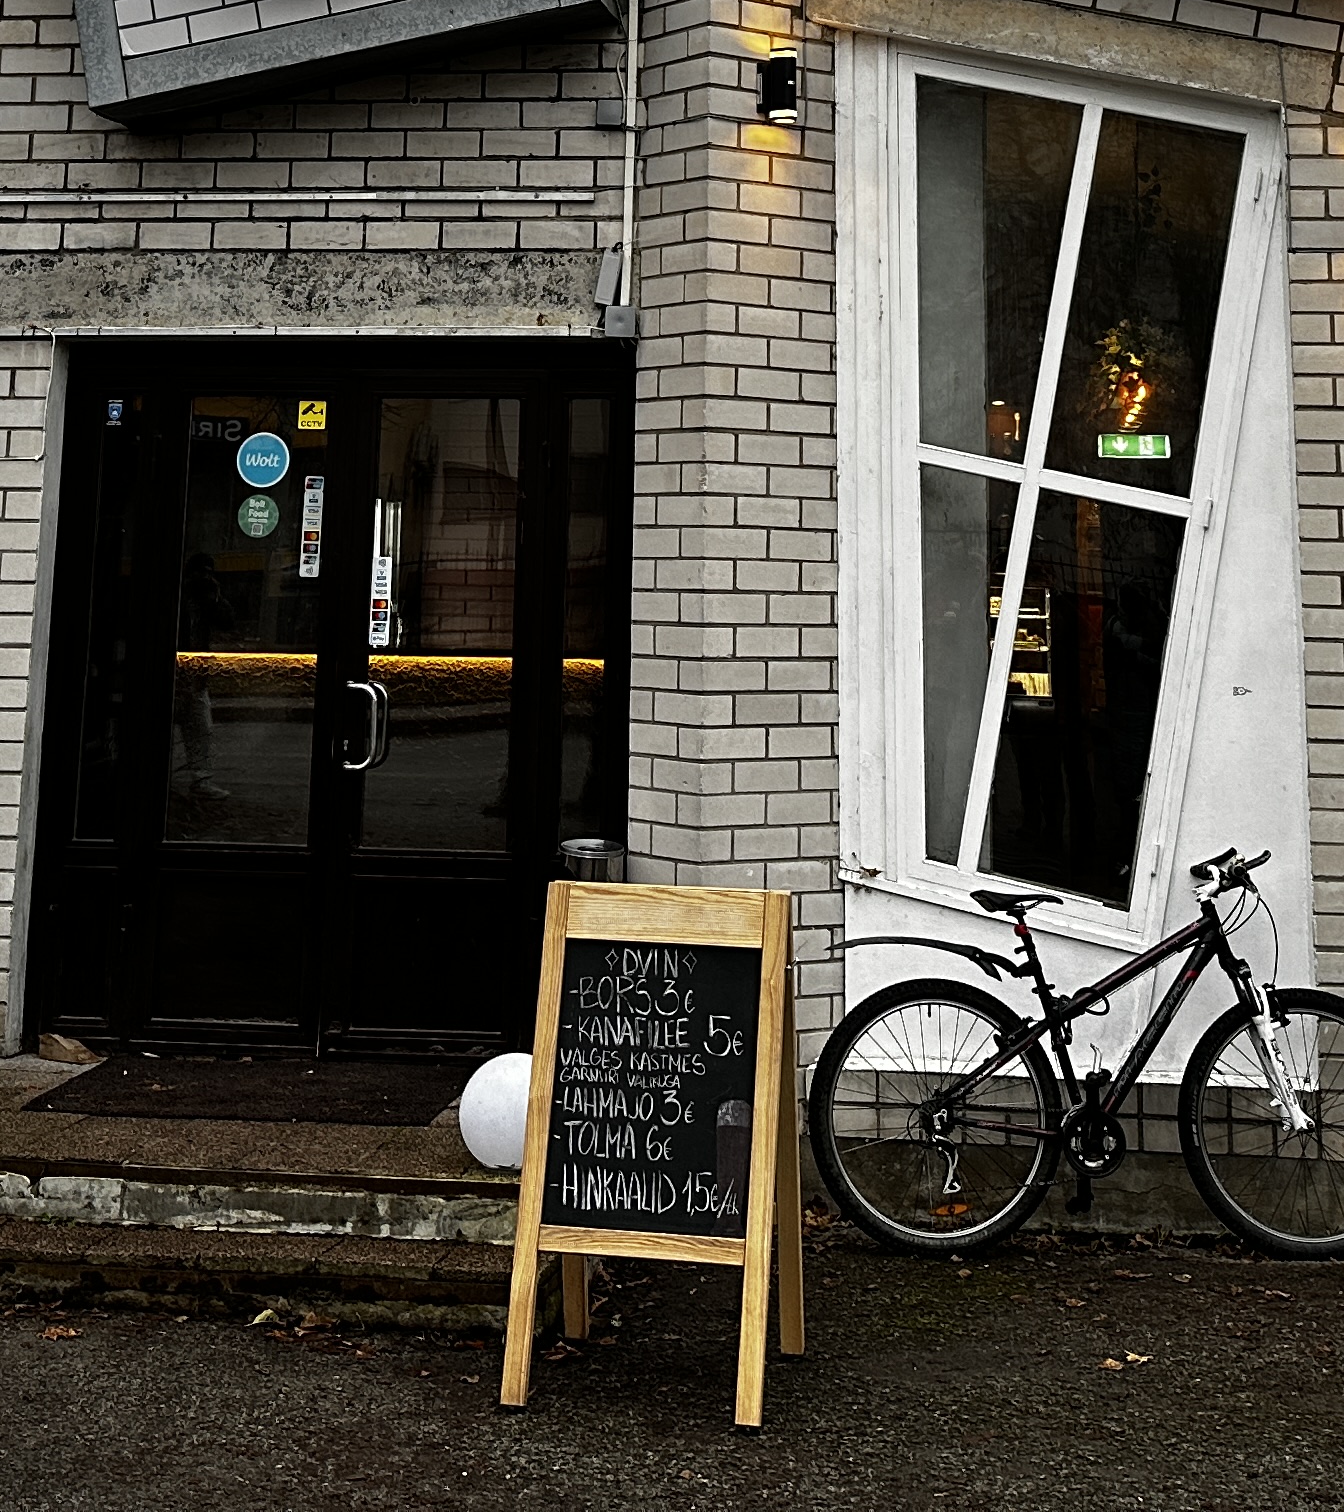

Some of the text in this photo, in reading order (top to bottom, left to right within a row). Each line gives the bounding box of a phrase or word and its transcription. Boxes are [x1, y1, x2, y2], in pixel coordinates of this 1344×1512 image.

[300, 420, 323, 428] CCTV
[245, 452, 281, 468] Wolt
[623, 947, 678, 978] DVIN
[578, 1015, 691, 1049] KANAFILEE
[560, 1047, 706, 1076] VALGES KASTMES
